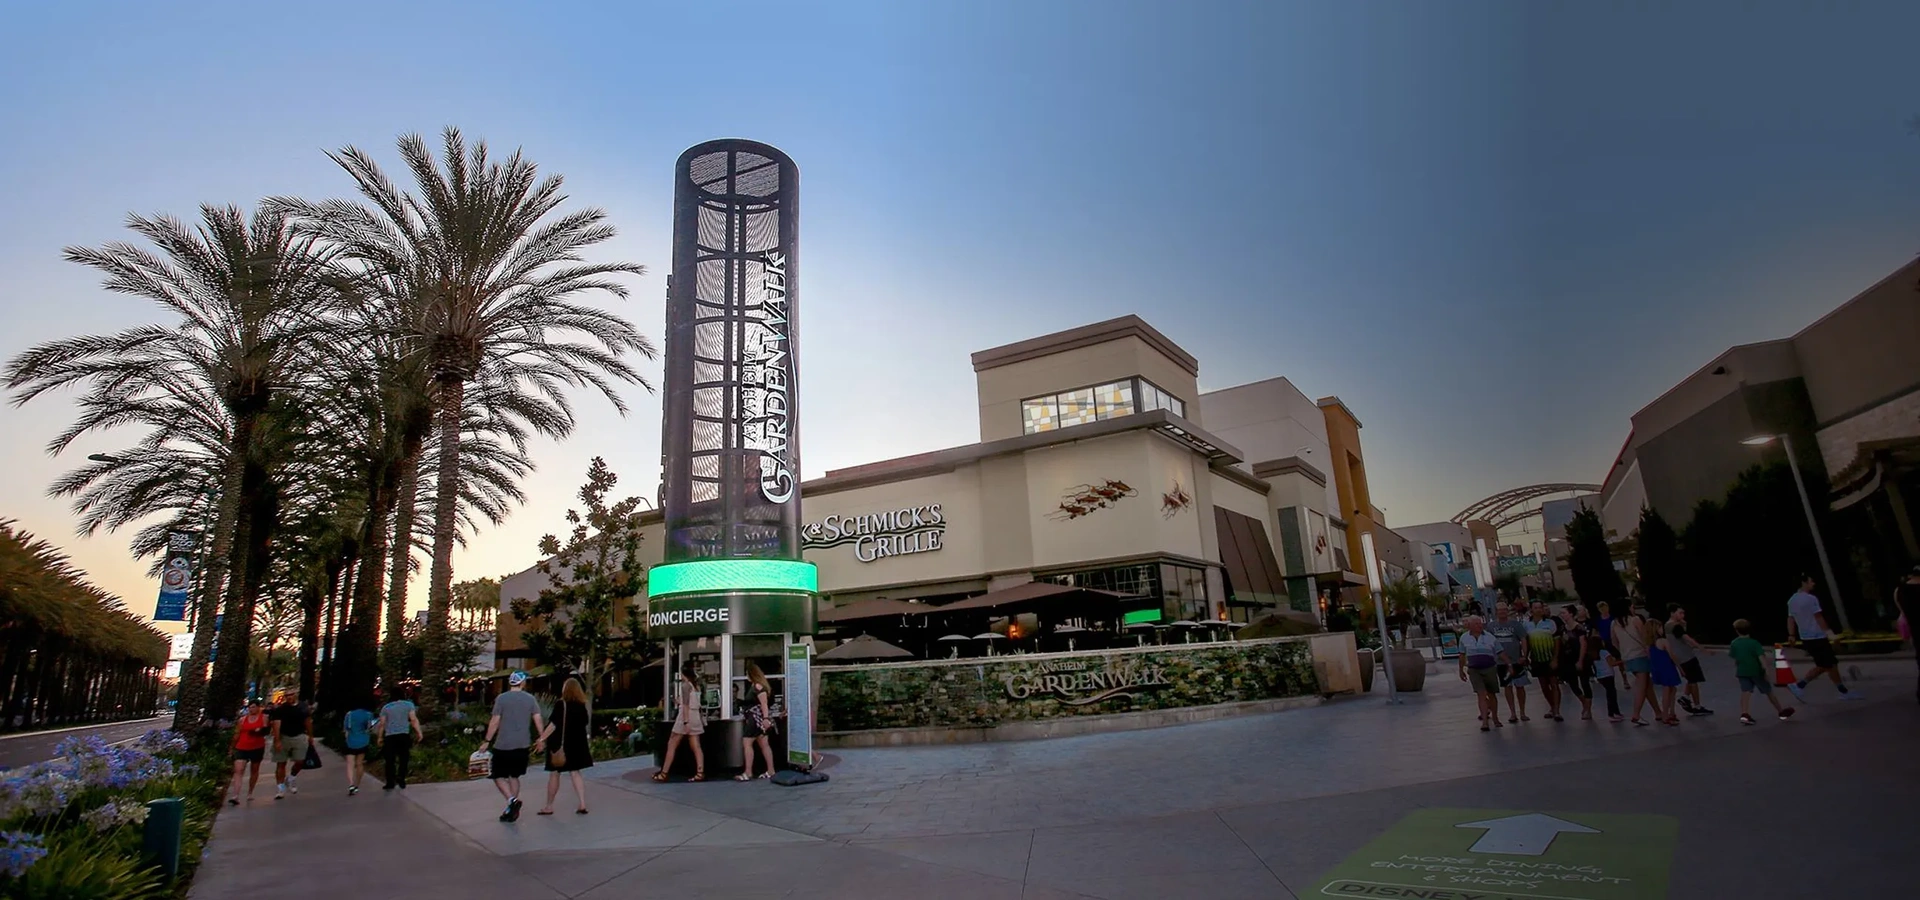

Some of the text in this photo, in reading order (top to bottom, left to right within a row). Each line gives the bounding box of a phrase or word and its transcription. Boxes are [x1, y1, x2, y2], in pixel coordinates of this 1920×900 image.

[760, 249, 794, 504] GARDENWALK
[742, 349, 757, 443] ANAHEIM
[855, 530, 943, 563] GRILLE
[649, 607, 730, 628] CONCIERGE
[1034, 661, 1087, 676] ANAHEIM
[1006, 666, 1170, 699] GARDENWALK
[1370, 861, 1630, 885] ENTERTAINMENT
[1398, 854, 1602, 875] MORE DINING,
[1449, 875, 1541, 889] SHOPS
